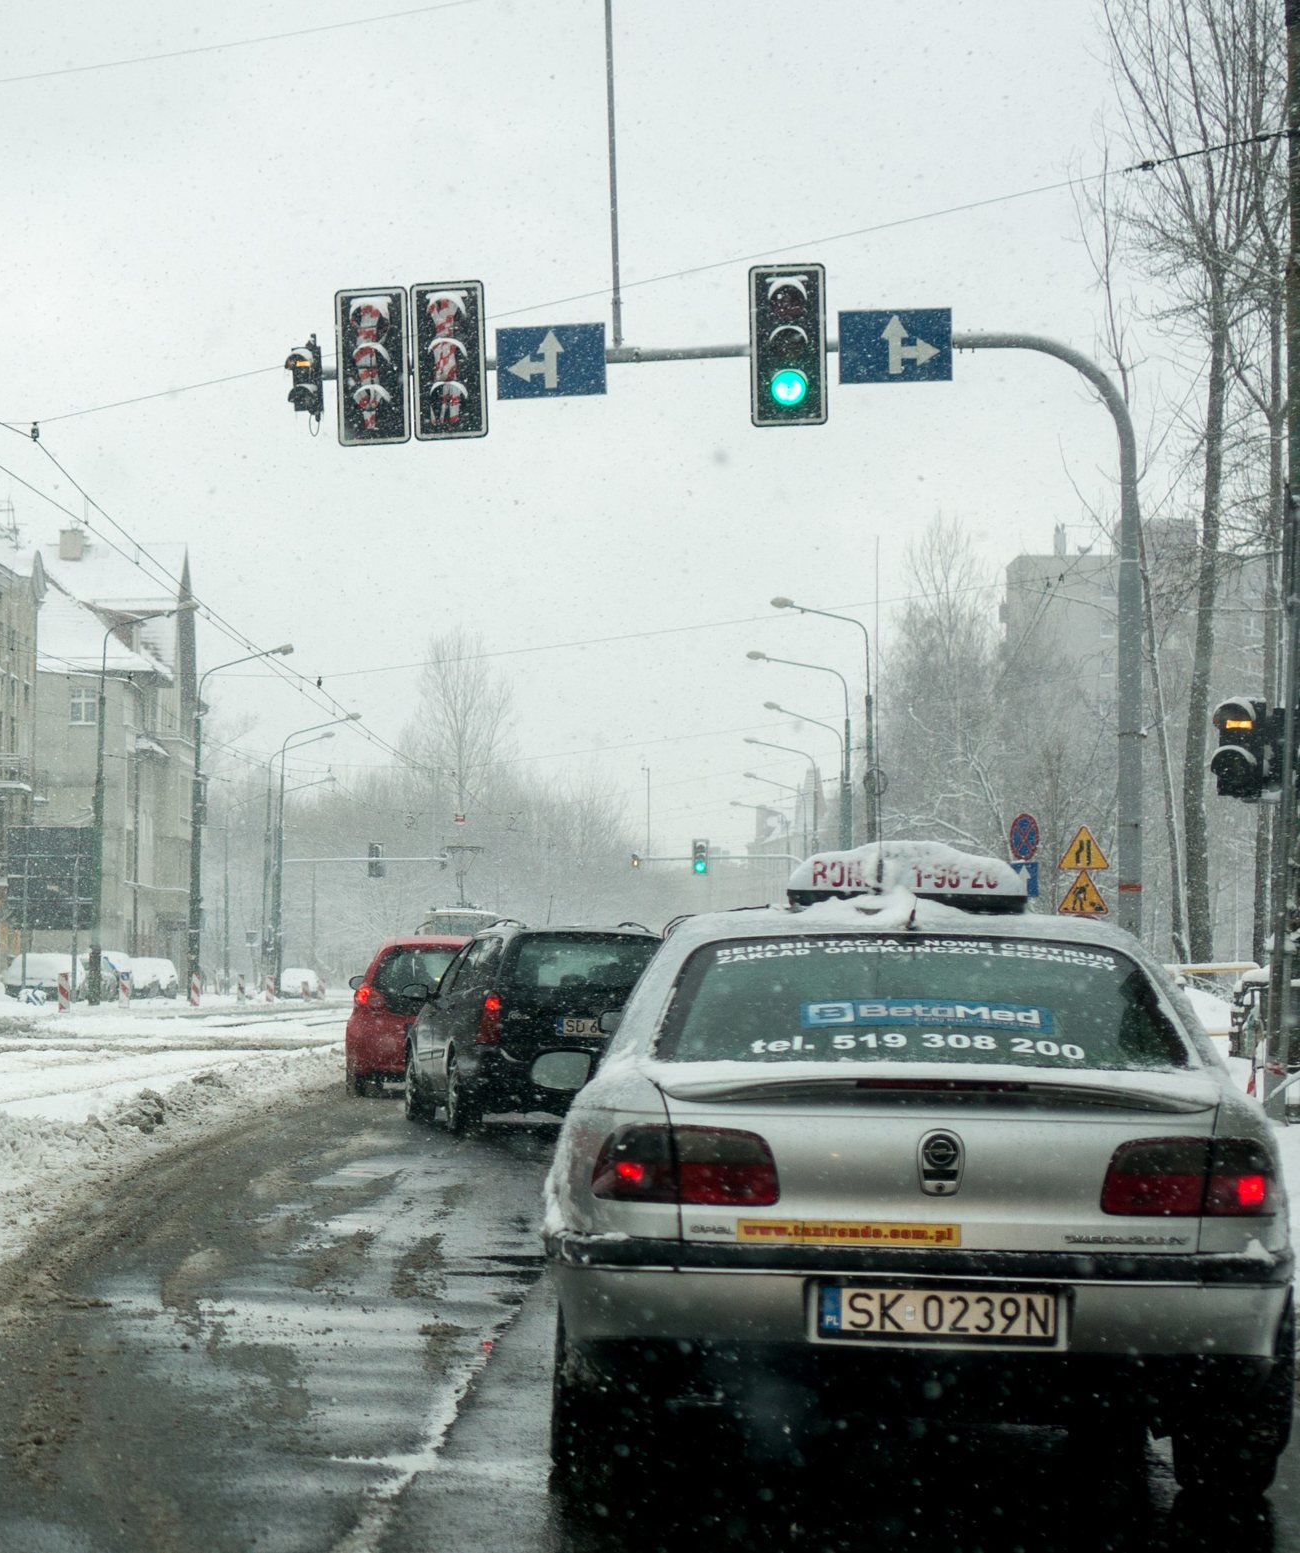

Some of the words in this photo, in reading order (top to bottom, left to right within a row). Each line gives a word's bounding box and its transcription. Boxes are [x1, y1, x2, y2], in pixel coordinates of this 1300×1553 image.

[716, 939, 899, 957] REHABILITACJA
[924, 939, 993, 949] NOWE
[1000, 943, 1115, 964] CENTRUM
[716, 948, 811, 965] ZAKŁAD
[859, 1004, 1042, 1025] BetaMed
[751, 1036, 815, 1053] tel.
[832, 1033, 907, 1049] 519
[922, 1033, 998, 1050] 308
[1010, 1037, 1085, 1060] 200
[825, 1315, 839, 1326] PL
[848, 1292, 904, 1330] SK
[923, 1295, 1050, 1335] 0239N
